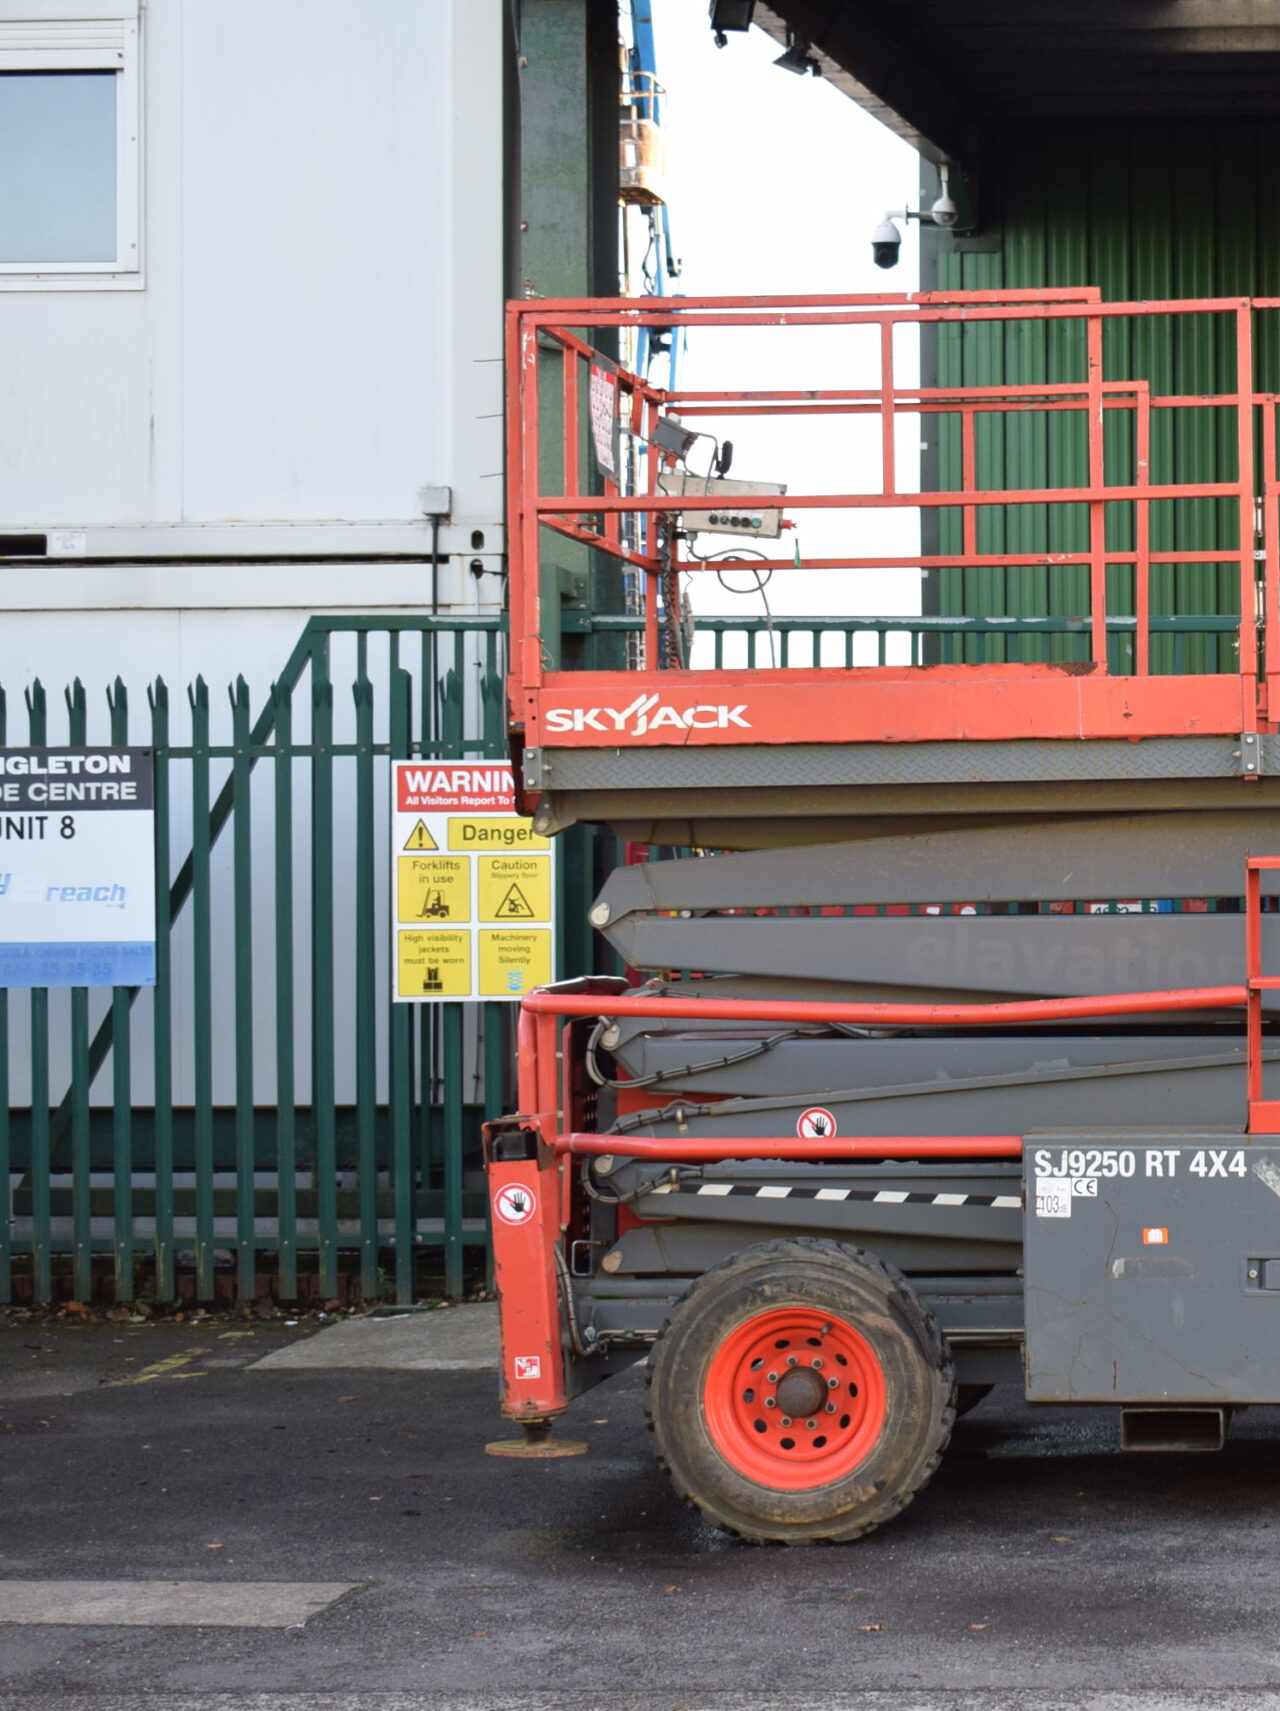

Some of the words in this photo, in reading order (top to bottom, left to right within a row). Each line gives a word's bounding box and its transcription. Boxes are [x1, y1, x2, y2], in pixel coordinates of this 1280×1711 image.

[546, 692, 752, 736] SKYJACK
[404, 770, 515, 793] WARNIN
[0, 783, 20, 801] E
[27, 781, 137, 801] CENTRE
[406, 796, 418, 805] All
[420, 796, 459, 805] Visitors
[461, 796, 496, 807] Report
[497, 796, 510, 805] To
[0, 816, 48, 840] NIT
[60, 815, 75, 840] 8
[462, 824, 535, 844] Danger
[412, 860, 460, 871] Forklifts
[491, 860, 538, 870] Caution
[419, 874, 429, 883] in
[433, 876, 454, 884] use
[491, 872, 519, 880] Slippery
[45, 884, 126, 902] reach
[404, 934, 424, 944] High
[427, 934, 463, 944] visibility
[491, 934, 537, 943] Machinery
[418, 945, 450, 955] jackets
[498, 945, 531, 954] moving
[404, 957, 425, 965] must
[429, 957, 440, 965] be
[442, 957, 464, 965] worn
[498, 956, 531, 965] Silently
[1034, 1150, 1136, 1177] SJ9250
[1145, 1150, 1180, 1177] RT
[1189, 1150, 1247, 1177] 4X4
